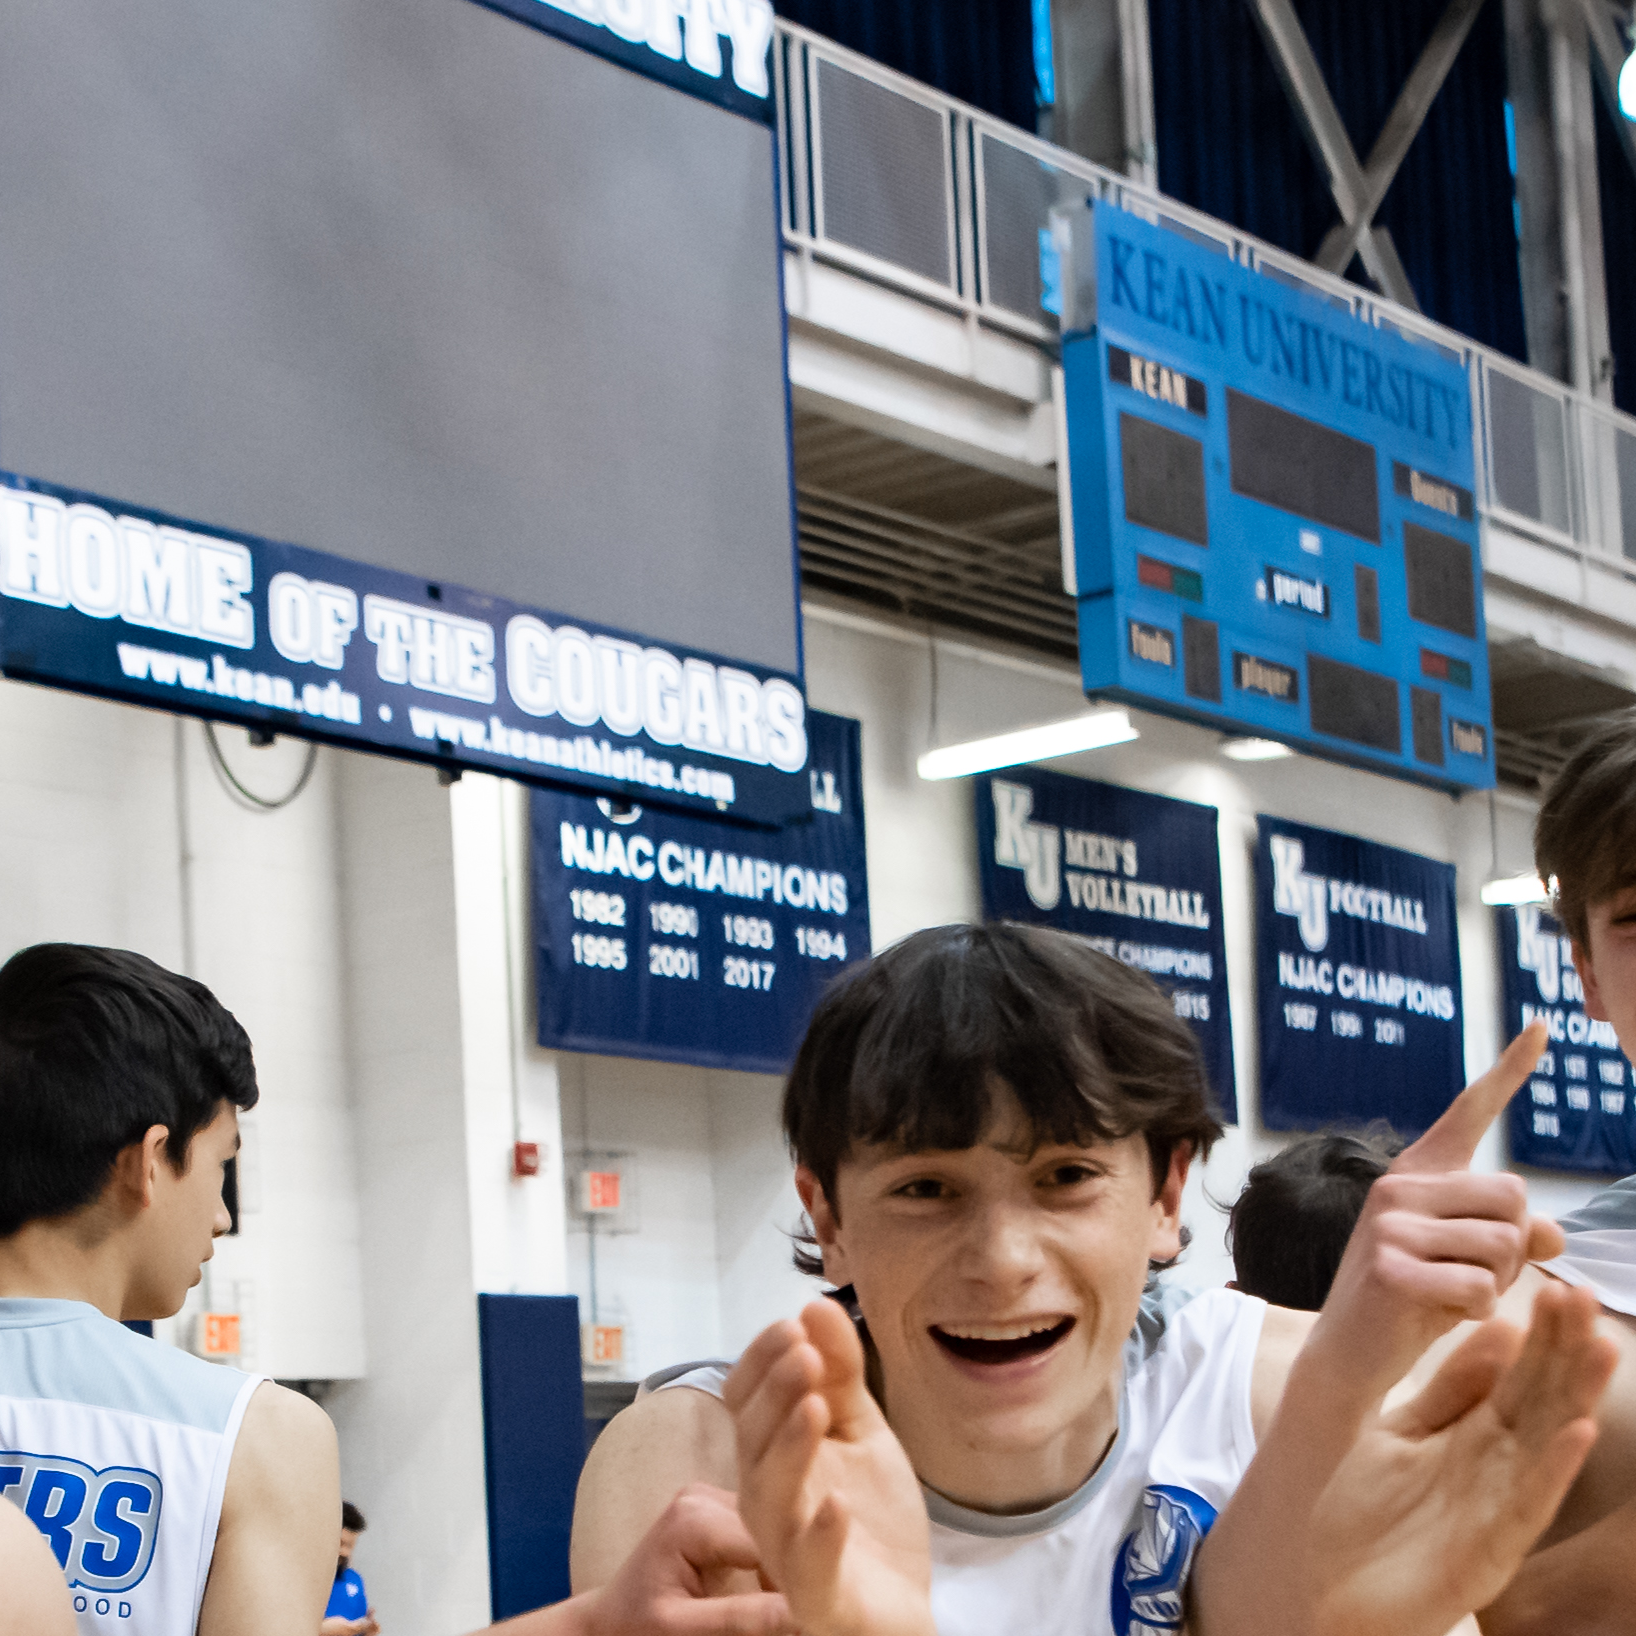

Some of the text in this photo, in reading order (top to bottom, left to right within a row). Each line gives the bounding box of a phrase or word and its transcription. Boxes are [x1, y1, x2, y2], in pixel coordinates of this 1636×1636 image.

[1109, 234, 1462, 450] KEAN UNIVERSITY
[1129, 355, 1189, 410] KEAN
[268, 571, 359, 671] OF
[363, 594, 497, 704] THE
[504, 614, 808, 774] COUGARS
[116, 642, 735, 803] www.kean.edu www.keanathletics.com
[560, 821, 849, 916] NJAC CHAMPIONS
[1065, 828, 1139, 878] MEN'S
[1066, 870, 1211, 931] VOLLEYBALL
[1330, 878, 1430, 936] FOOTBALL
[649, 944, 700, 981] 2001
[723, 955, 777, 992] 2017
[1278, 951, 1456, 1022] NJAC CHAMPIONS
